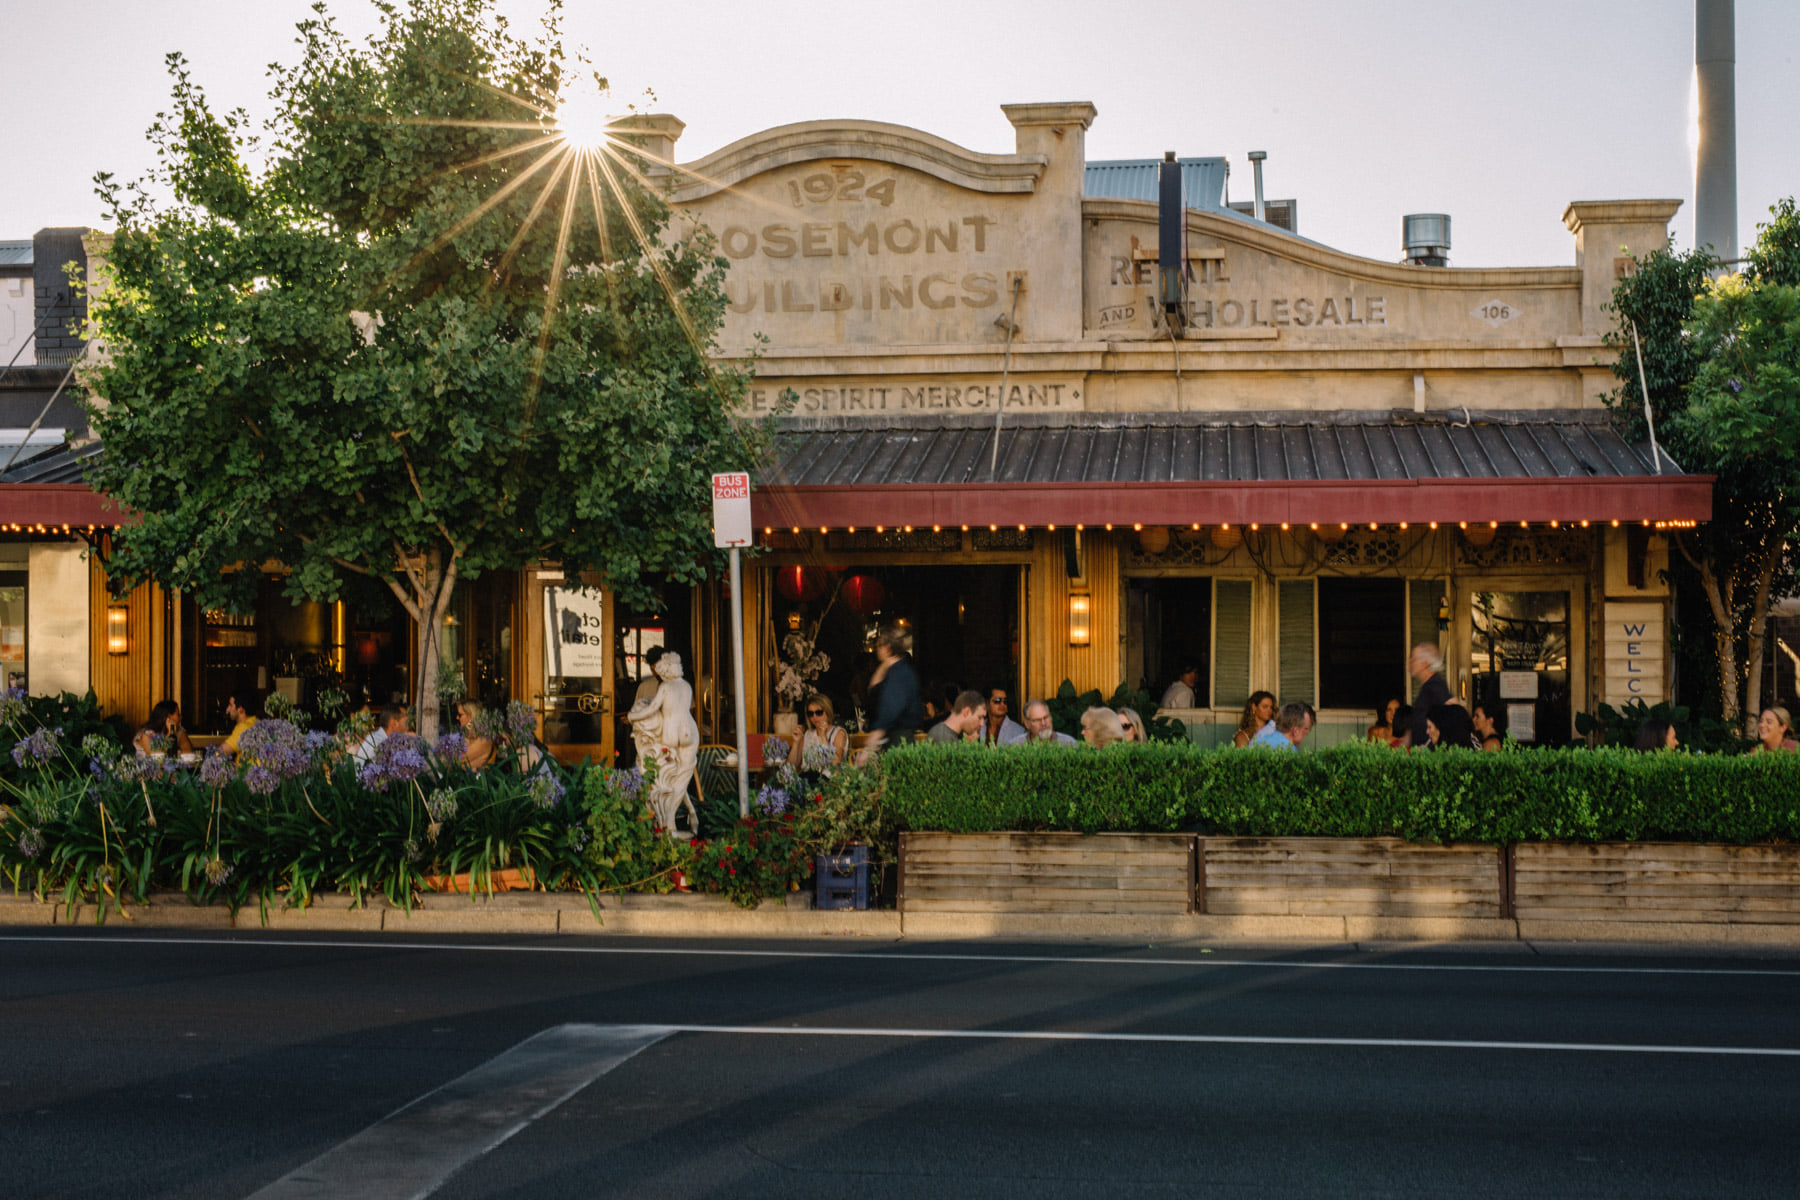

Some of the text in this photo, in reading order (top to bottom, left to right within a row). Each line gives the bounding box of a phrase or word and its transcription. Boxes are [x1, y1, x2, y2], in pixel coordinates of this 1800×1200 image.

[787, 171, 896, 207] 1924
[724, 271, 998, 313] UILDINGS
[1100, 307, 1135, 323] AND
[1480, 304, 1510, 320] 106
[805, 387, 891, 412] SPIRIT
[901, 384, 1066, 411] MERCHANT
[719, 477, 742, 486] BUS
[716, 487, 746, 498] ZONE
